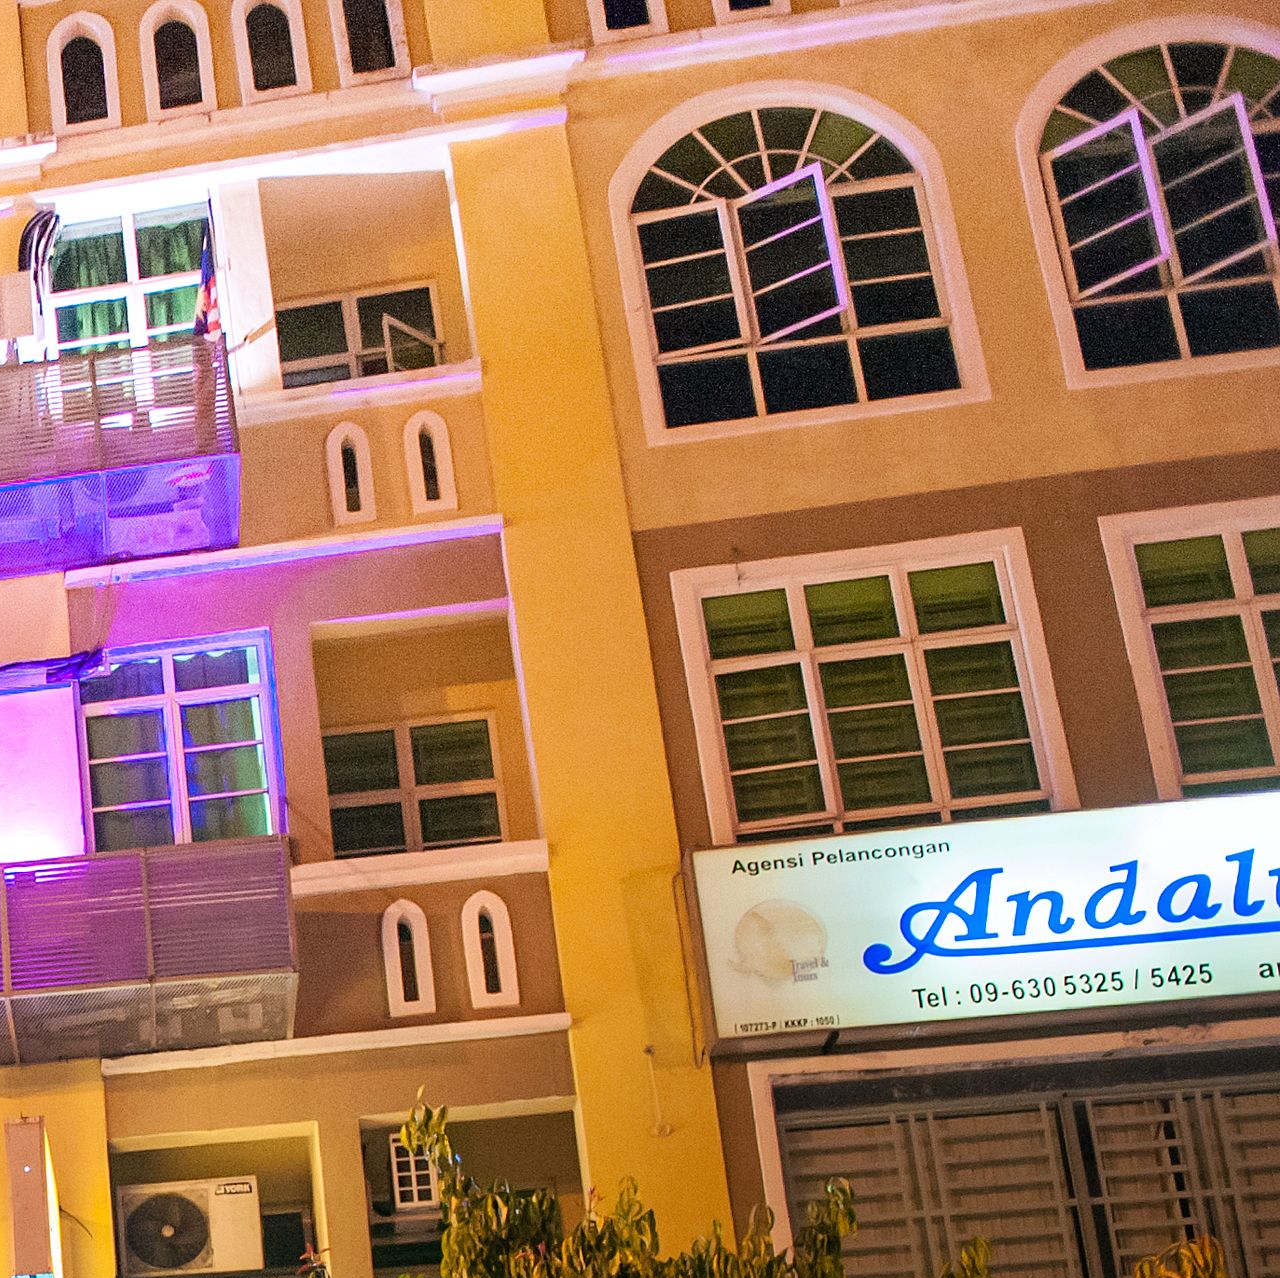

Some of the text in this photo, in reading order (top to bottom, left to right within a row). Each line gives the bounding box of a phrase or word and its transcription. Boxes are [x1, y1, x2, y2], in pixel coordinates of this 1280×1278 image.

[731, 838, 952, 877] Agensi Pelancongan
[862, 848, 1280, 976] Andal
[912, 986, 949, 1010] Tel
[970, 973, 1057, 1006] 09-630
[1064, 969, 1126, 997] 5325
[1150, 961, 1213, 990] 5425
